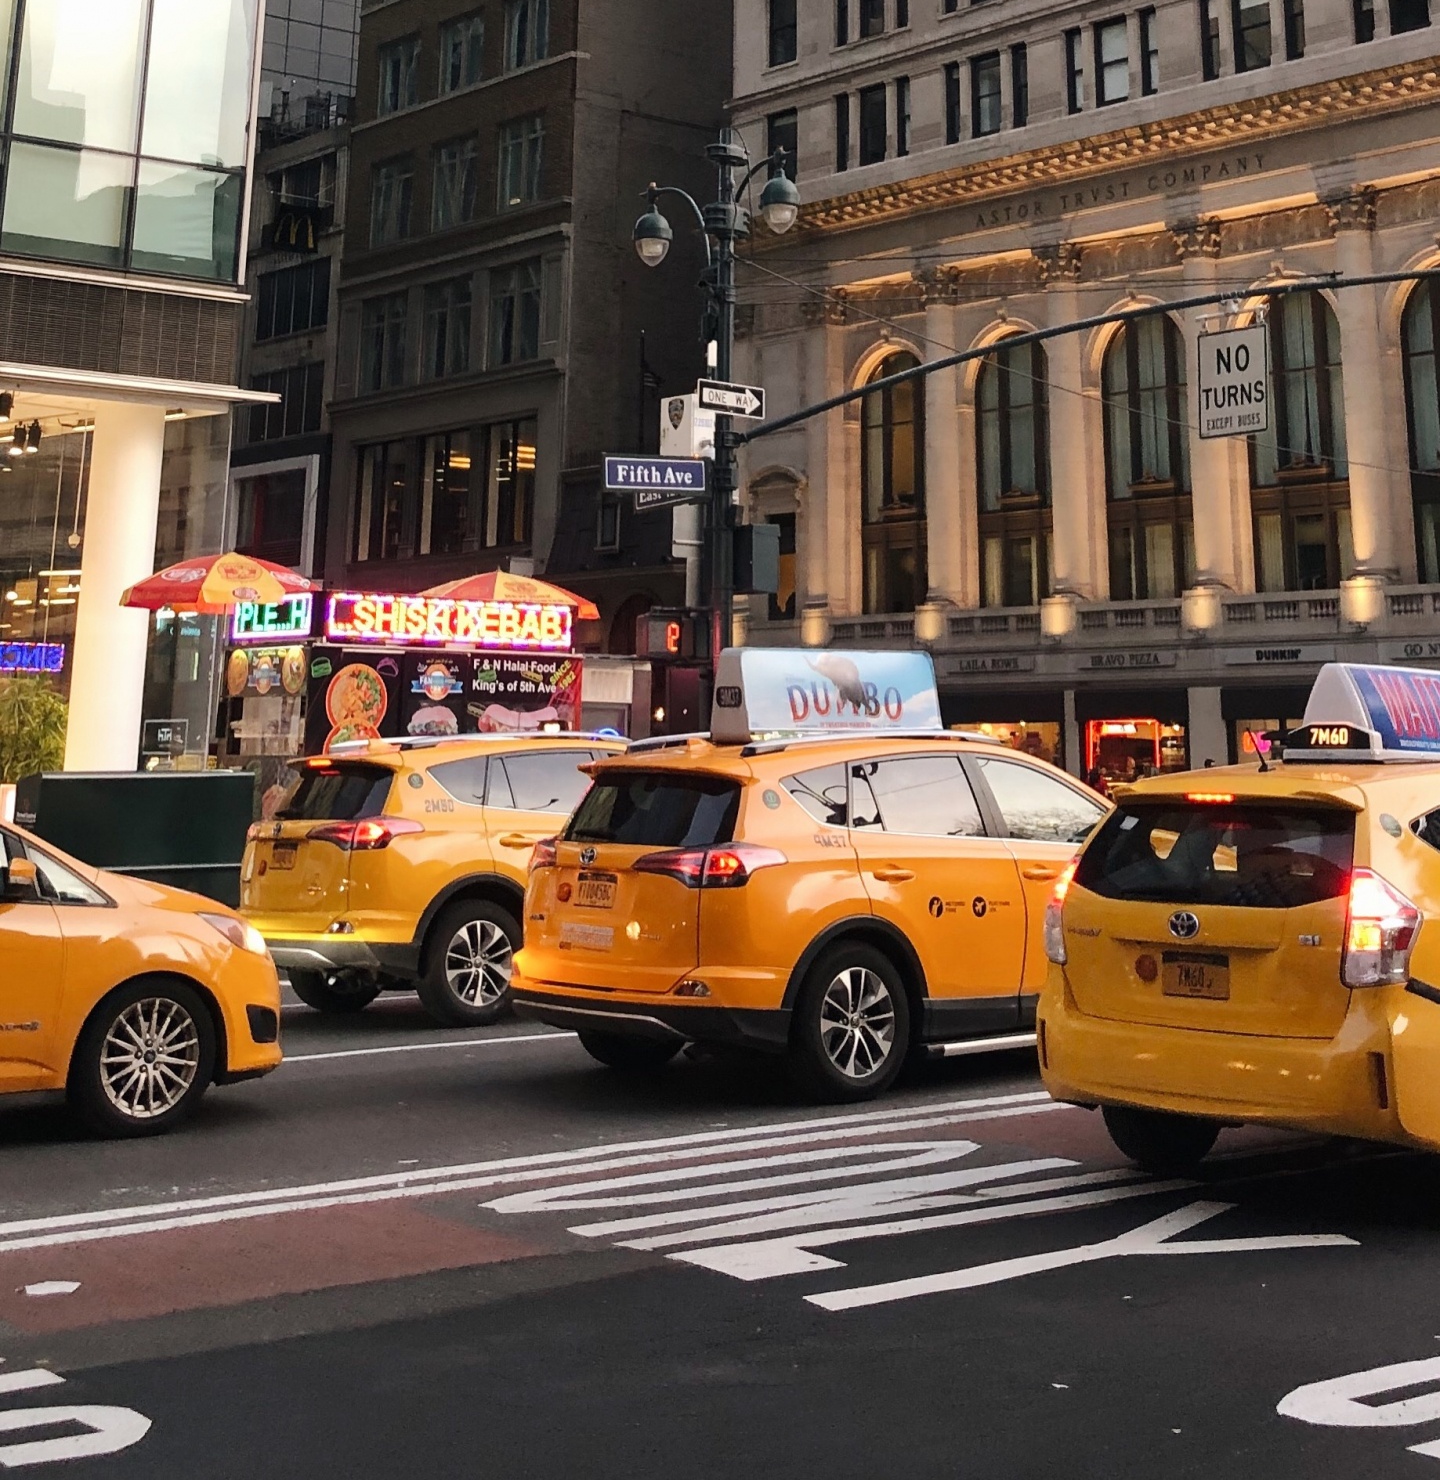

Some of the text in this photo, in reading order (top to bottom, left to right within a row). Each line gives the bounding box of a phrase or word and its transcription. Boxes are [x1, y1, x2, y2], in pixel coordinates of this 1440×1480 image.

[975, 201, 1044, 227] ASTOR
[1147, 153, 1265, 191] COMPANY
[1216, 343, 1250, 375] NO
[708, 390, 755, 409] ONE WAY
[1202, 380, 1265, 410] TURNS
[1206, 412, 1261, 431] EXCEPT BUSES
[616, 464, 693, 484] Fifth Ave
[457, 604, 562, 640] KEBAB
[1091, 653, 1160, 667] BRAVO PIZZA
[1256, 649, 1301, 661] DUNKIN'
[473, 659, 556, 673] F & N Halal Food
[550, 659, 573, 685] SINCE
[472, 679, 557, 694] King's of 5th Ave
[1310, 728, 1348, 745] 7M60
